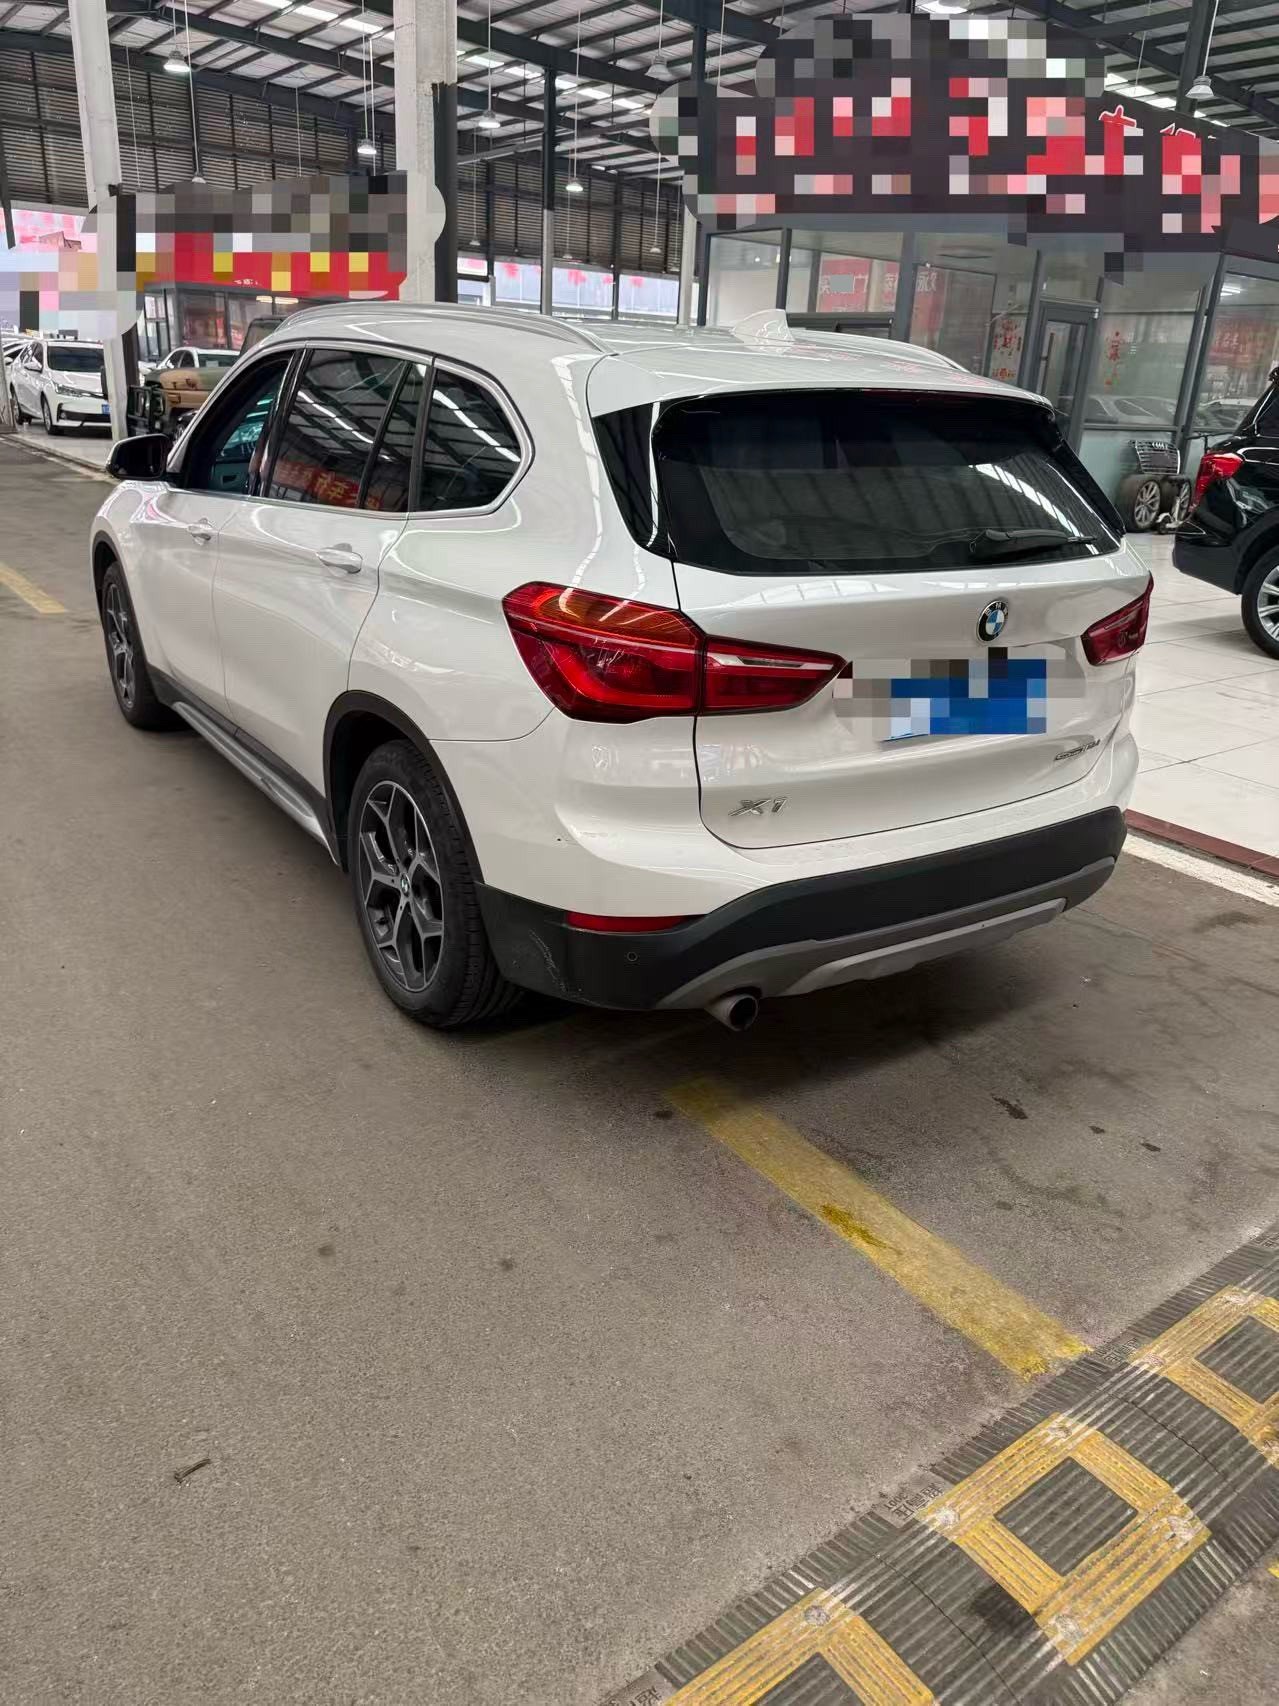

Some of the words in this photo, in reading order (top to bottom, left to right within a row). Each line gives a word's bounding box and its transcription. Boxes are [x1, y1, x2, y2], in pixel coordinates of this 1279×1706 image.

[728, 796, 787, 816] X1
[893, 1482, 943, 1521] 超高压
